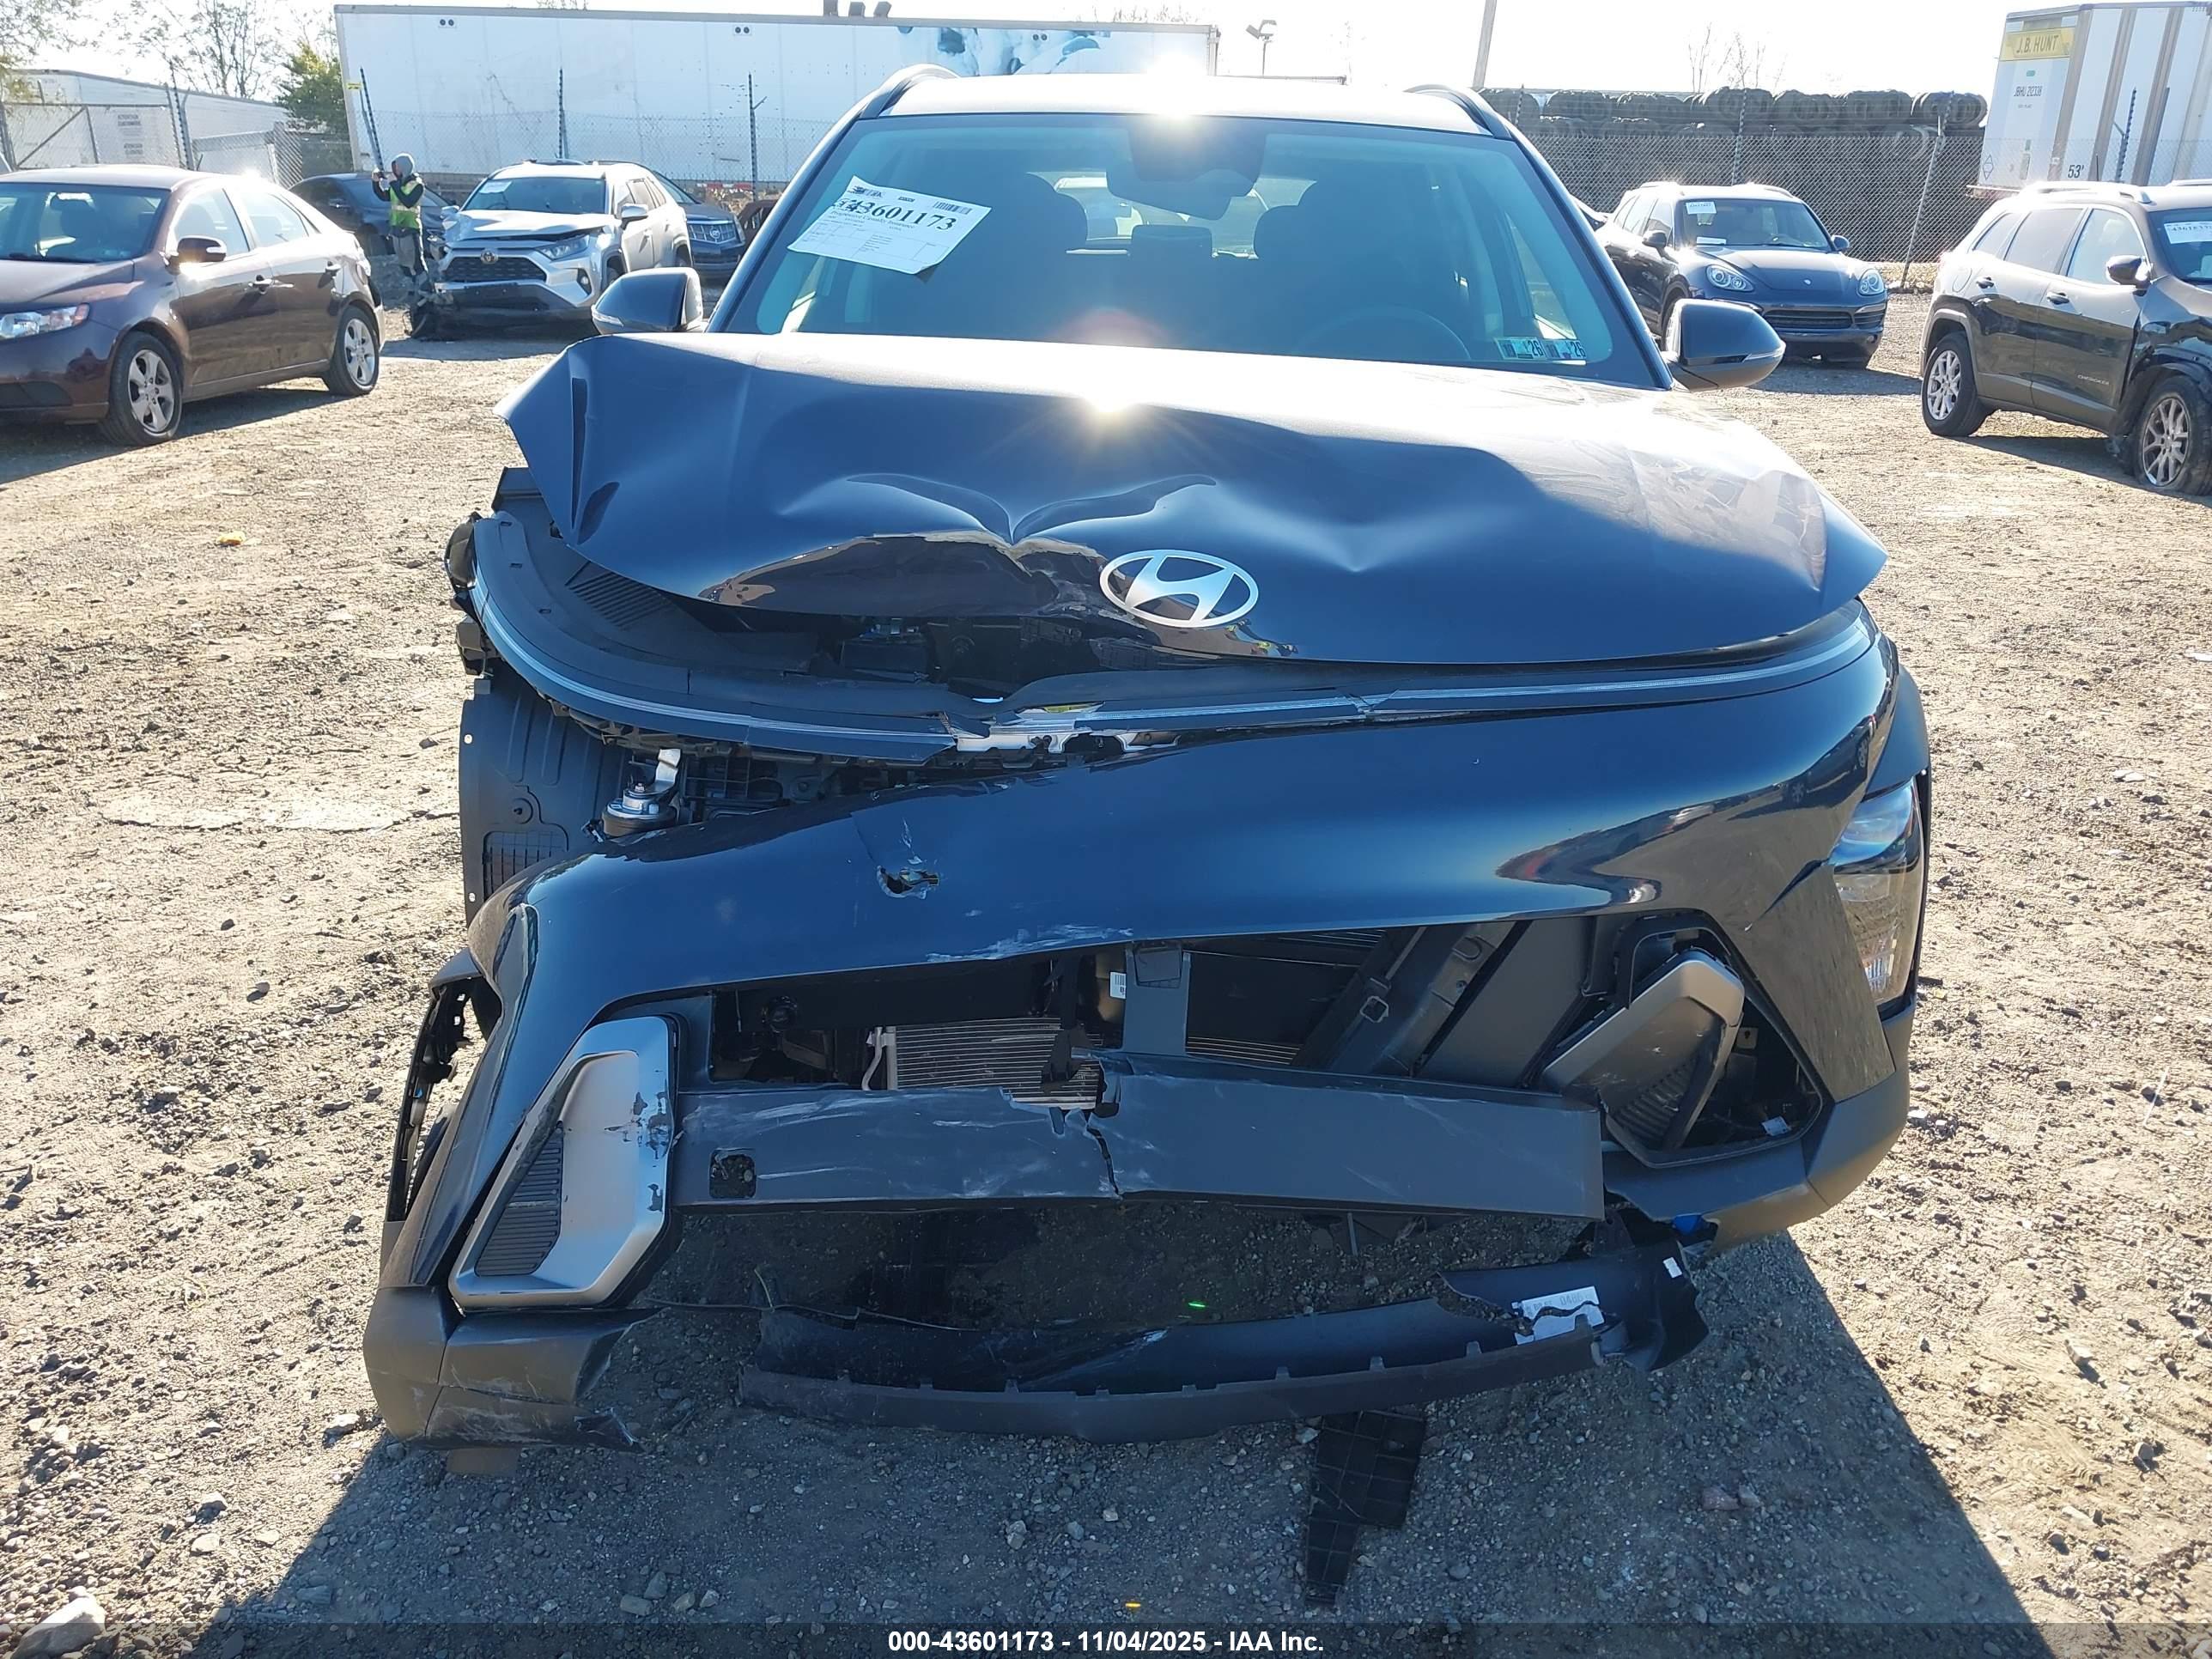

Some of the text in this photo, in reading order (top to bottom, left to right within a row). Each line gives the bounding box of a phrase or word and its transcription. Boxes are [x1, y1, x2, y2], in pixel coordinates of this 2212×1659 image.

[2015, 34, 2059, 54] J.B. HUNT
[2067, 164, 2085, 179] 53'
